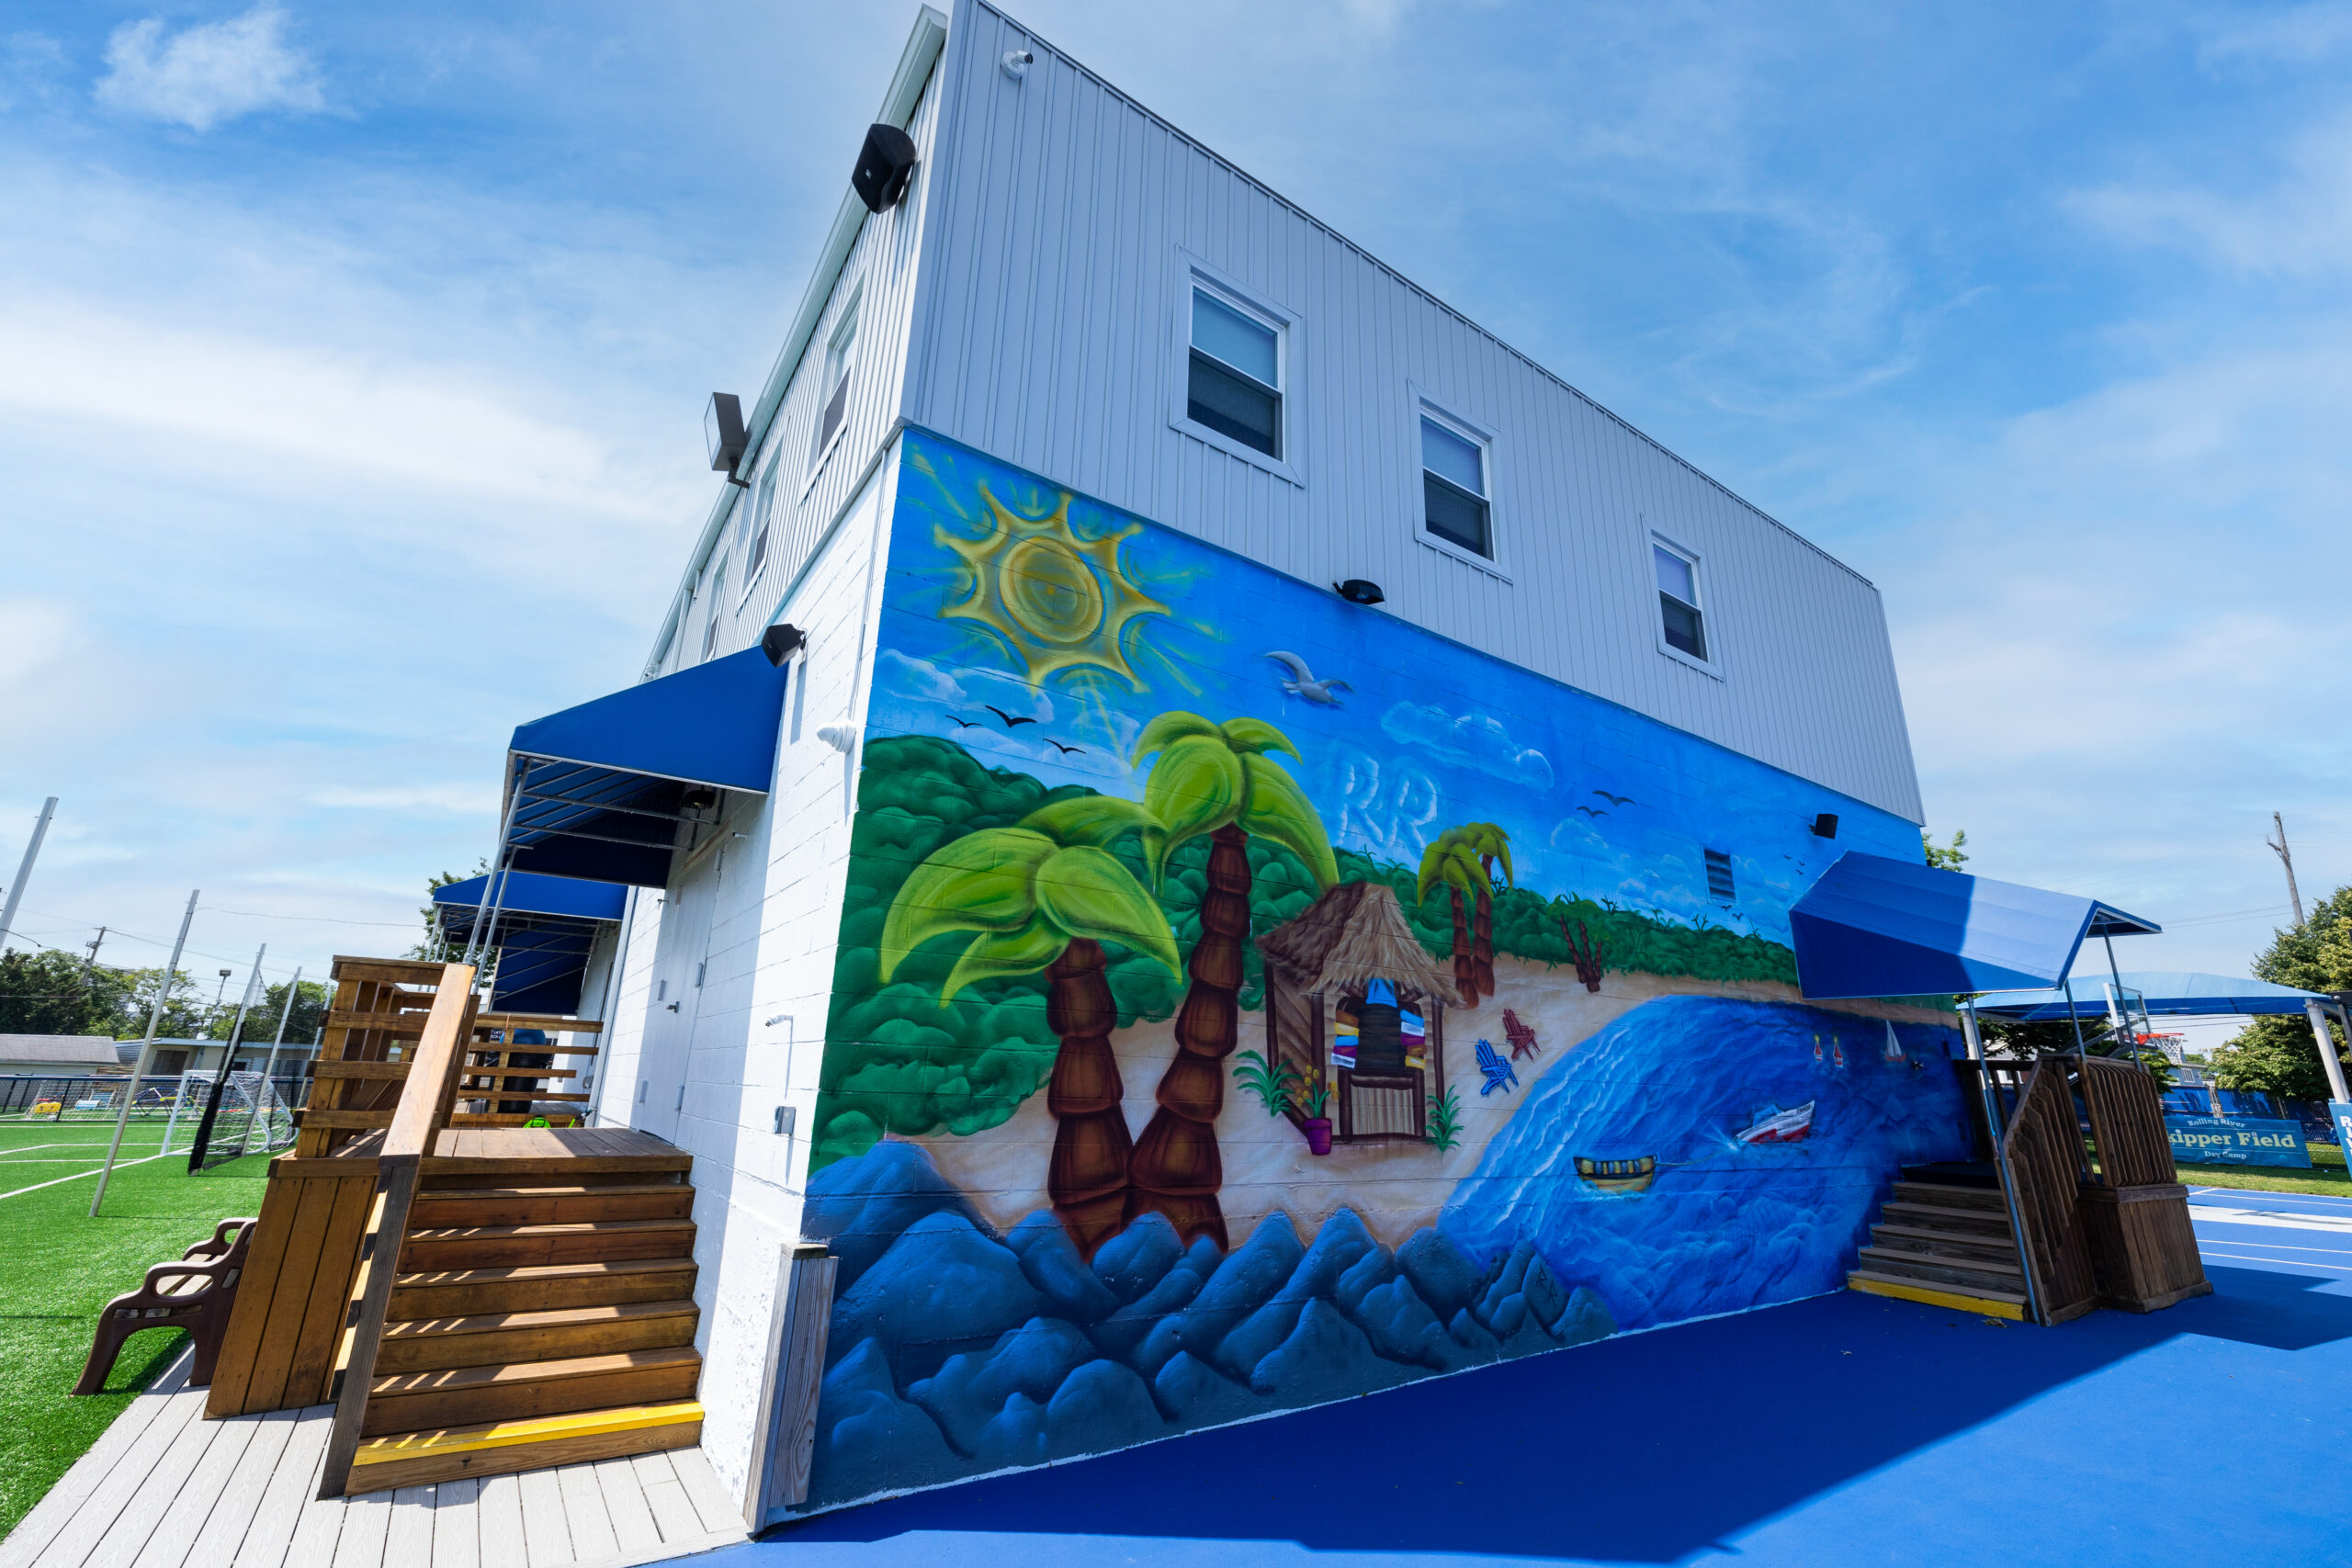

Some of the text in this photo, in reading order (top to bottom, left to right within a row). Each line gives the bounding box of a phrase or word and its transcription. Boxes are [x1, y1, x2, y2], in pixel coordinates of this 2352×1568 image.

[2187, 1118, 2246, 1128] Rolling River
[2168, 1129, 2297, 1148] kipper Field
[2204, 1151, 2247, 1160] Day Camp
